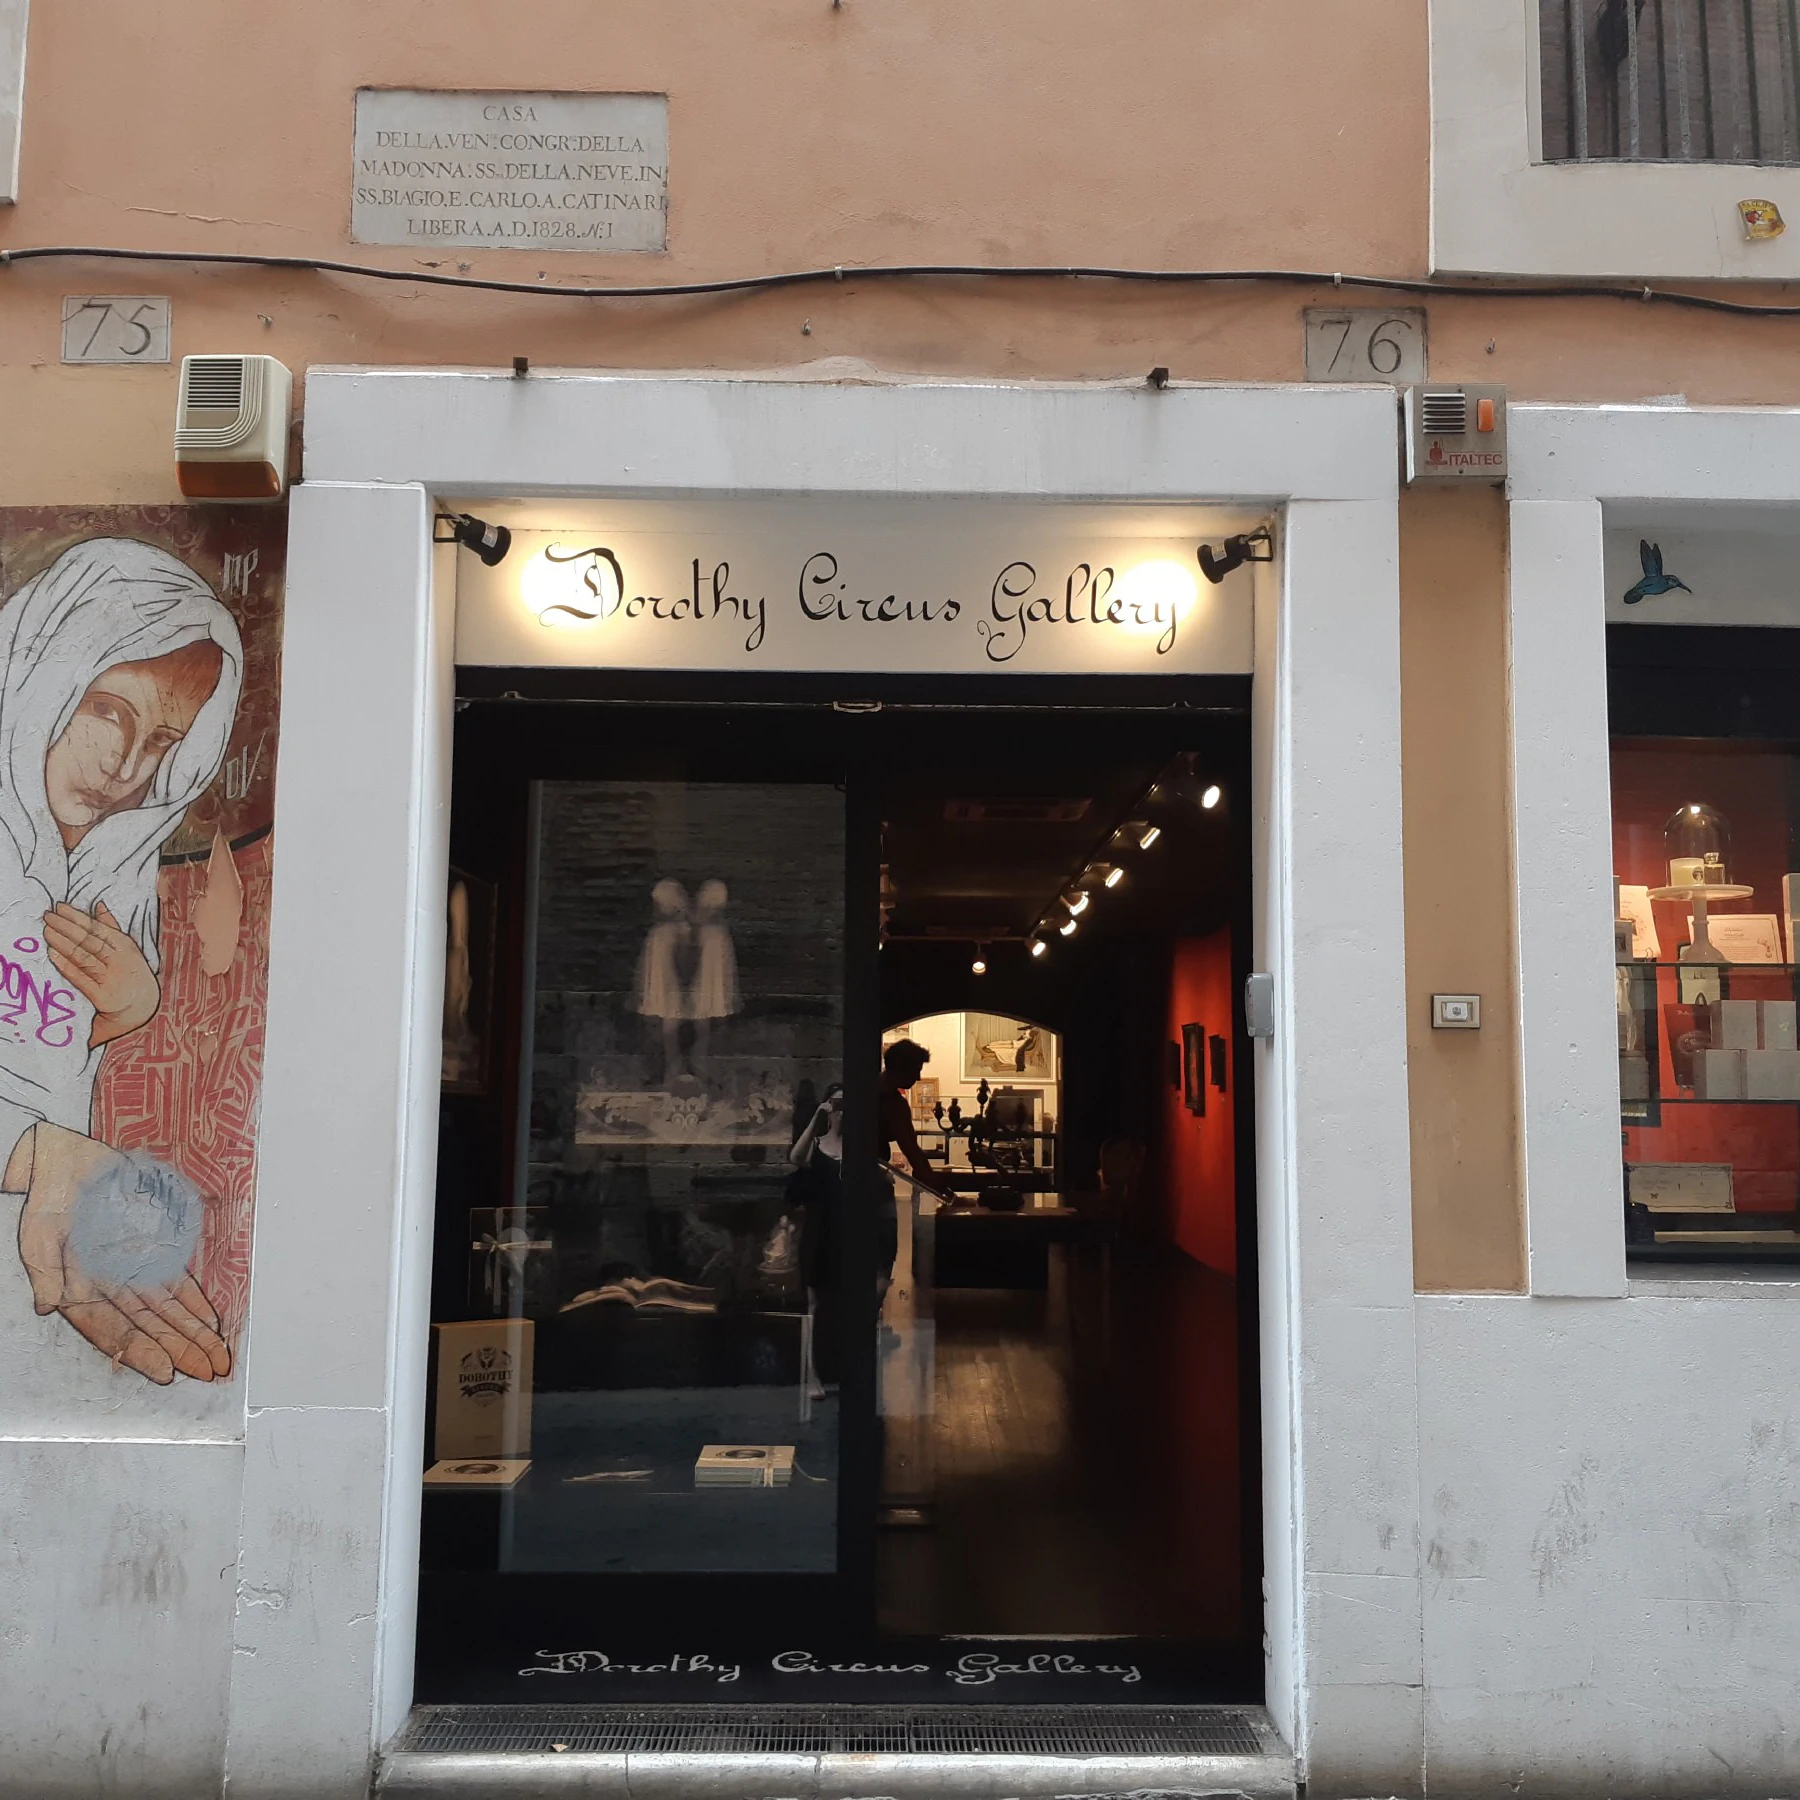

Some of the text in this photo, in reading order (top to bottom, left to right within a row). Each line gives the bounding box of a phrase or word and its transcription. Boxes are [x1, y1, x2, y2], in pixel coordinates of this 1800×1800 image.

[483, 105, 538, 122] CASA
[82, 303, 156, 357] 75
[1320, 319, 1412, 374] 76
[1449, 454, 1503, 466] ITALTEC
[539, 542, 1177, 662] Dorothy Circus Gallery
[459, 1369, 514, 1383] DOROTHY
[517, 1649, 1142, 1685] Dorothy Circus Gallery
